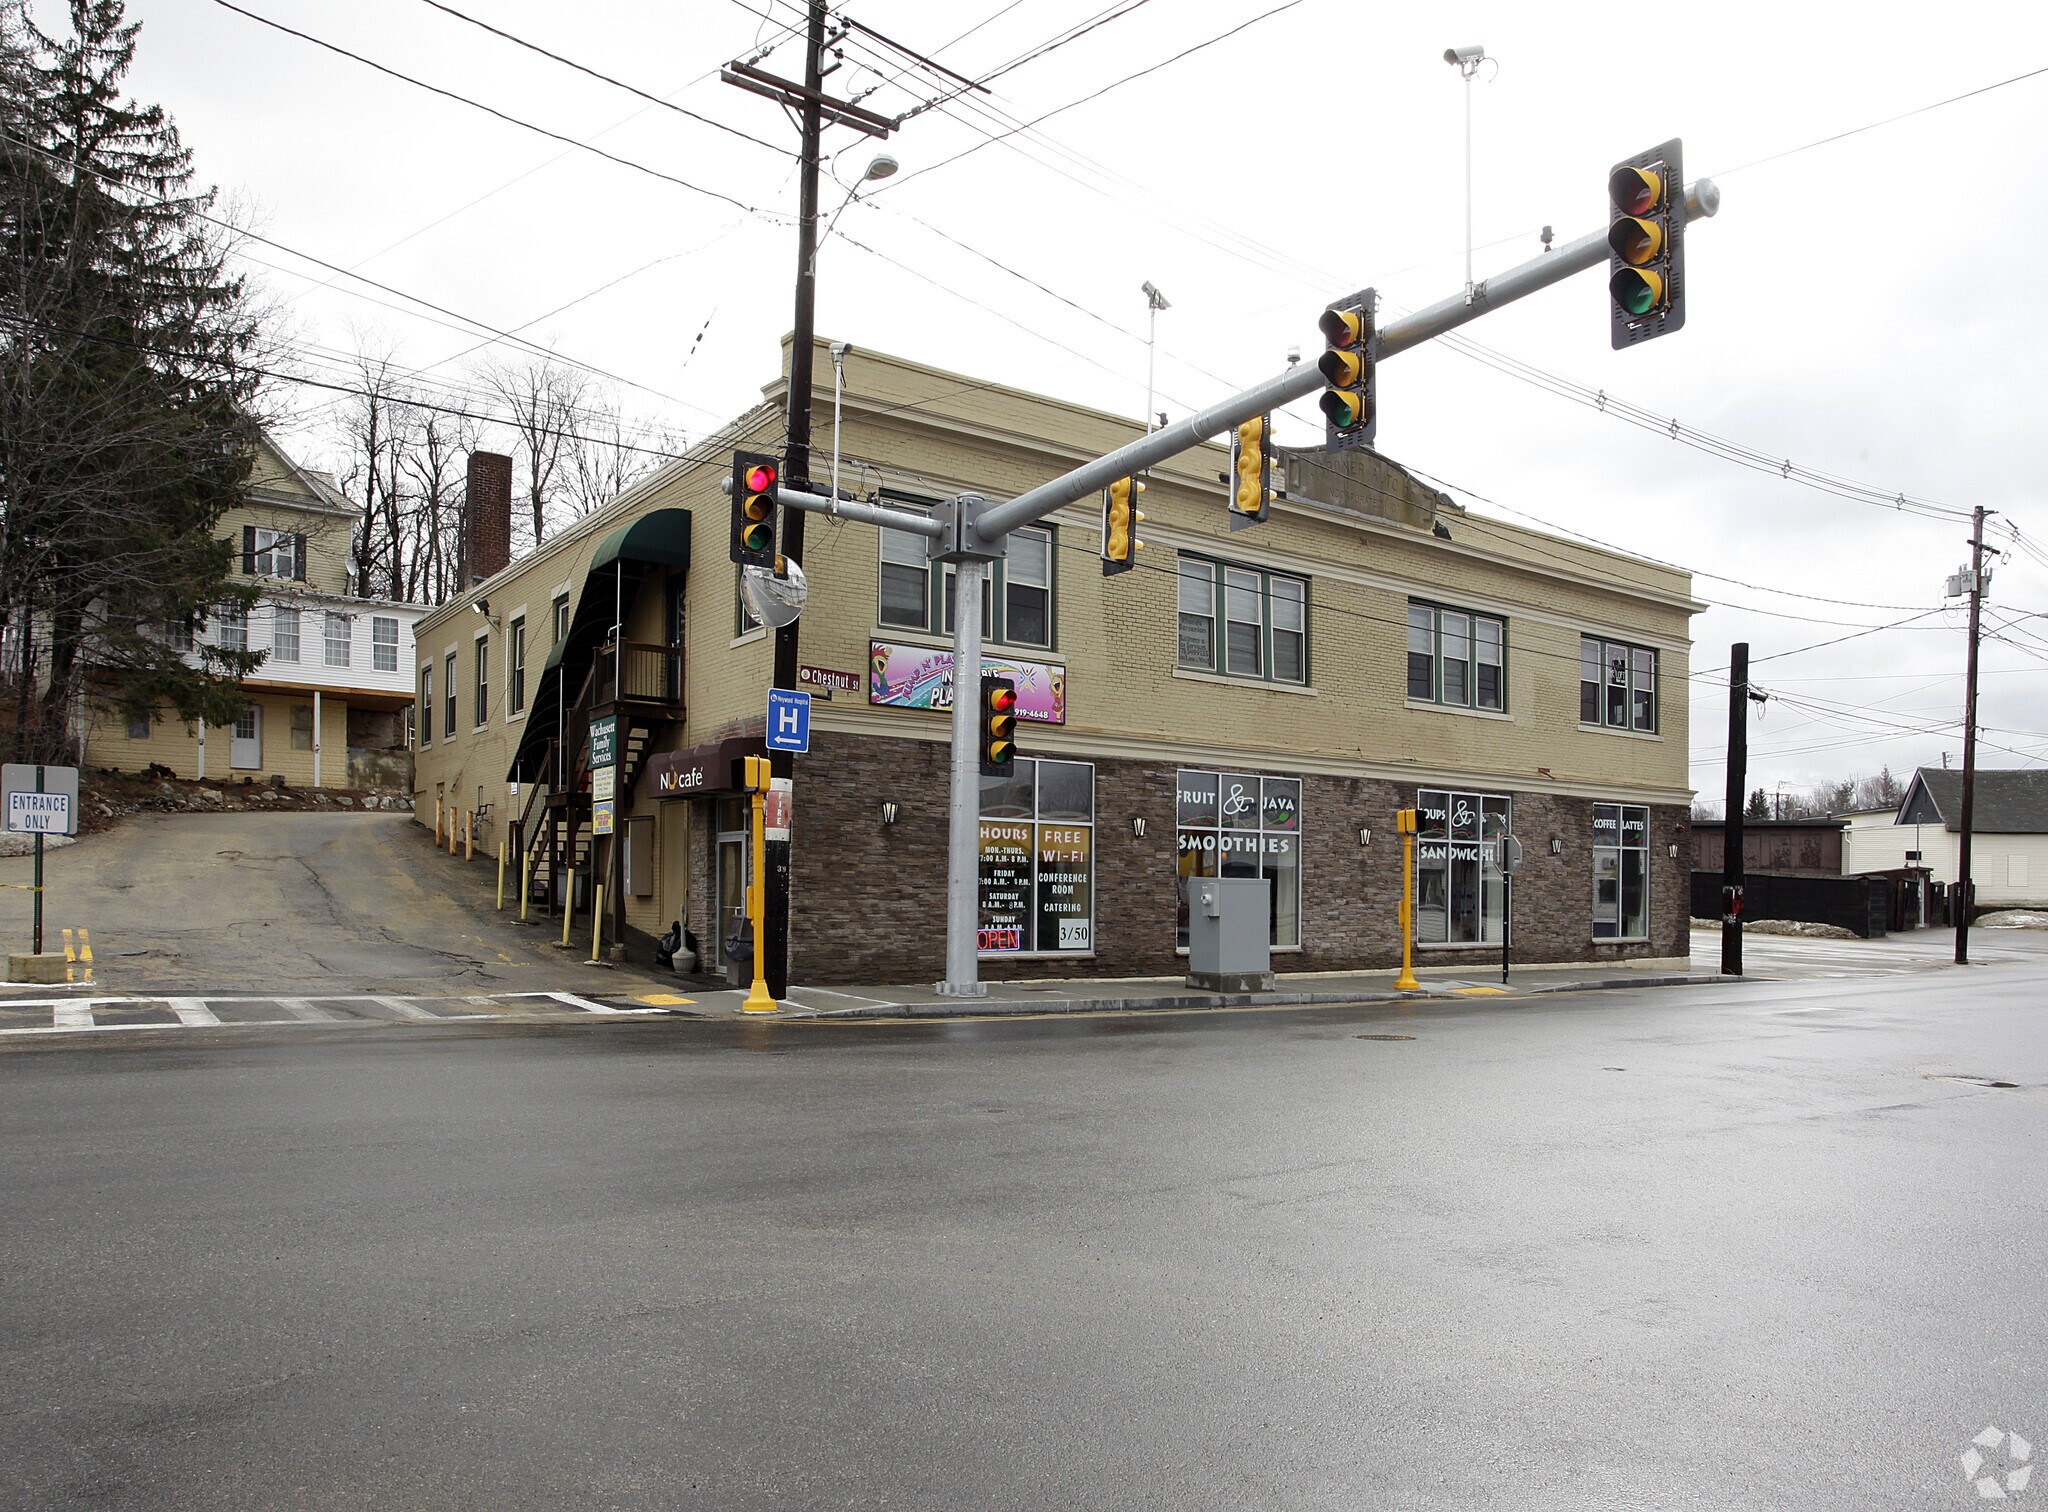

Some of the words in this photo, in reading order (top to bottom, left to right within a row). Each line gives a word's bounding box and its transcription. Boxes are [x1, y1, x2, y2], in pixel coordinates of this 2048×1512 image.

[812, 669, 849, 689] Chestnut
[902, 668, 920, 701] JUMP
[933, 655, 954, 666] PLA
[779, 706, 798, 734] H
[1014, 708, 1048, 719] 919-4648
[590, 722, 615, 738] Wachusett
[593, 734, 610, 751] Family
[592, 750, 611, 765] Services
[13, 795, 66, 812] ENTRANCE
[1177, 790, 1215, 805] FRUIT
[1223, 784, 1254, 815] &
[1263, 797, 1294, 811] JAVA
[1420, 808, 1446, 820] OUPS
[1452, 800, 1475, 827] &
[25, 814, 50, 830] ONLY
[1594, 819, 1617, 829] COFFEE
[1622, 820, 1644, 831] LATTES
[980, 827, 1028, 840] HOURS
[1045, 830, 1081, 844] FREE
[1179, 835, 1290, 853] SMOOTHIES
[1043, 849, 1084, 863] WI-FI
[1038, 872, 1087, 883] CONFERENCE
[1052, 885, 1074, 895] ROOM
[1044, 903, 1082, 912] CATERING
[977, 930, 1018, 949] OPEN
[1060, 927, 1088, 941] 3/50
